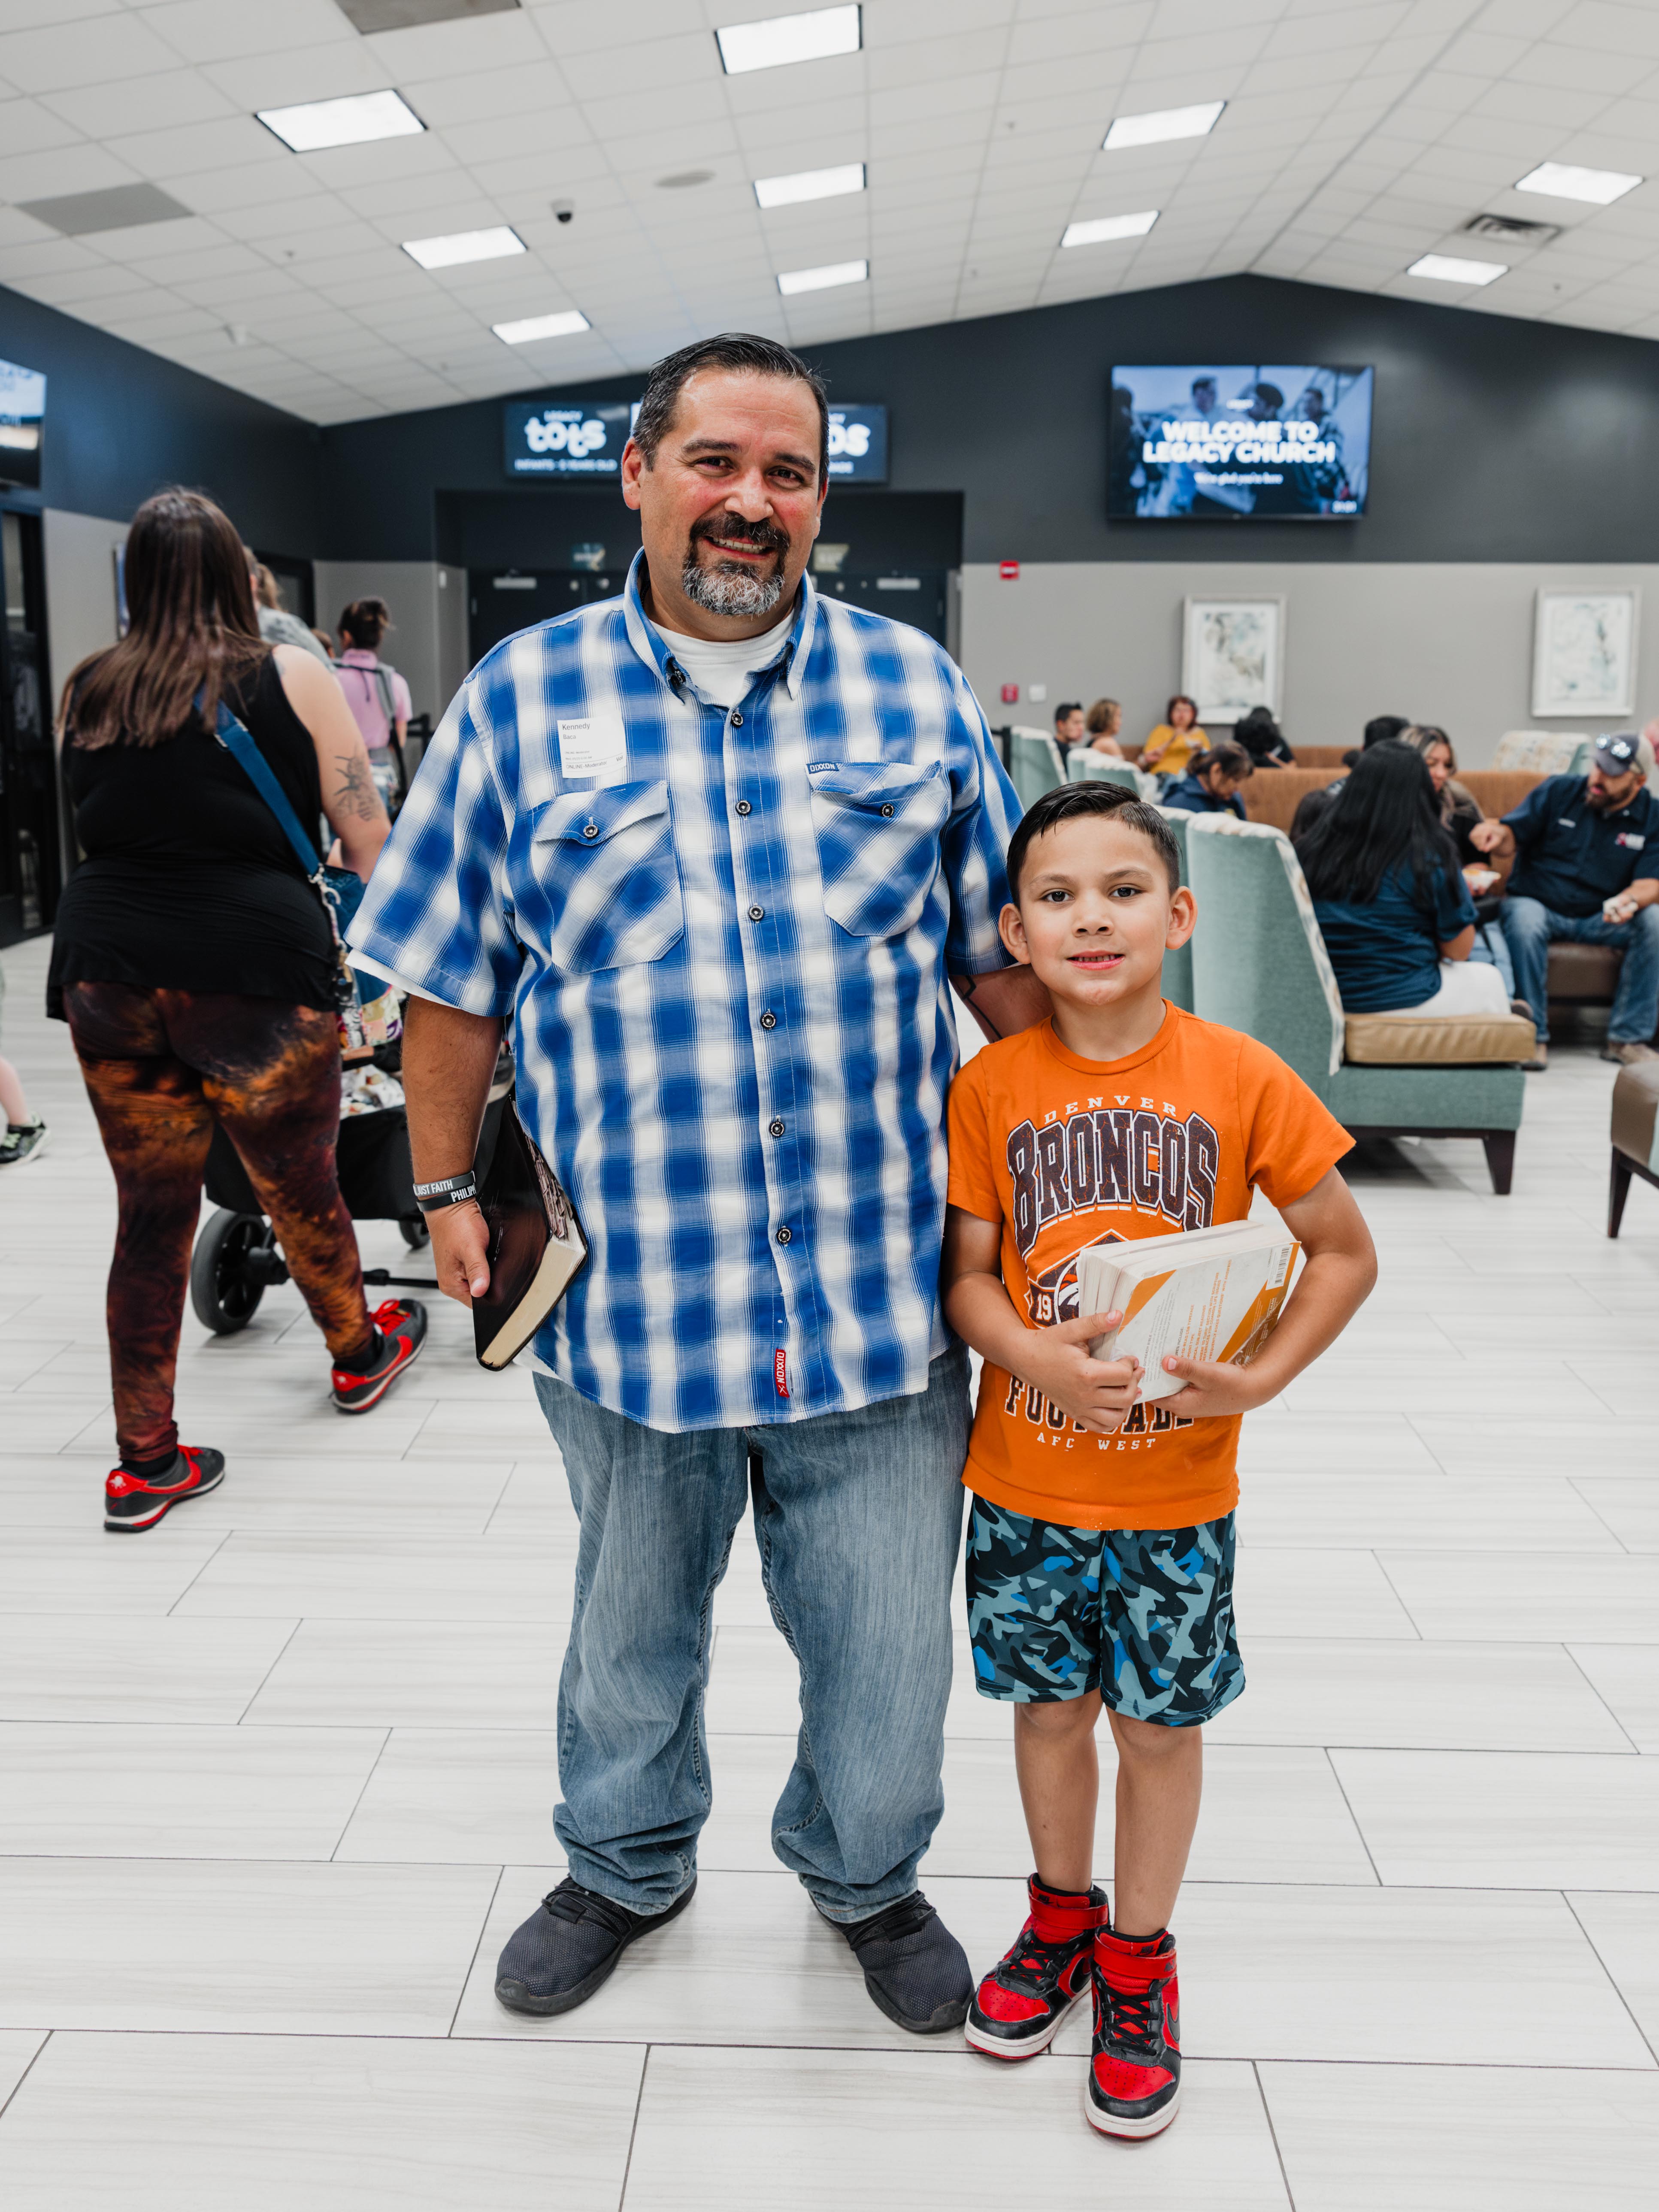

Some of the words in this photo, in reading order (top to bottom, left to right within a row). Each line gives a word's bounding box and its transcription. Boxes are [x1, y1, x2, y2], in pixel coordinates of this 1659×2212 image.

[1162, 421, 1283, 442] WELCOME
[1284, 421, 1319, 442] TO
[1142, 441, 1235, 463] LEGACY
[1235, 441, 1335, 463] CHURCH
[810, 763, 836, 772] DIXXON
[1044, 1095, 1176, 1125] DENVER
[417, 1185, 430, 1195] JUST
[431, 1180, 454, 1193] FAITH
[1006, 1109, 1220, 1260] BRONCOS
[1036, 1293, 1052, 1321] 19
[1202, 1334, 1210, 1361] REFERENCES
[776, 1352, 785, 1384] DIXXON
[1037, 1432, 1075, 1449] AFC
[1098, 1438, 1156, 1450] WEST
